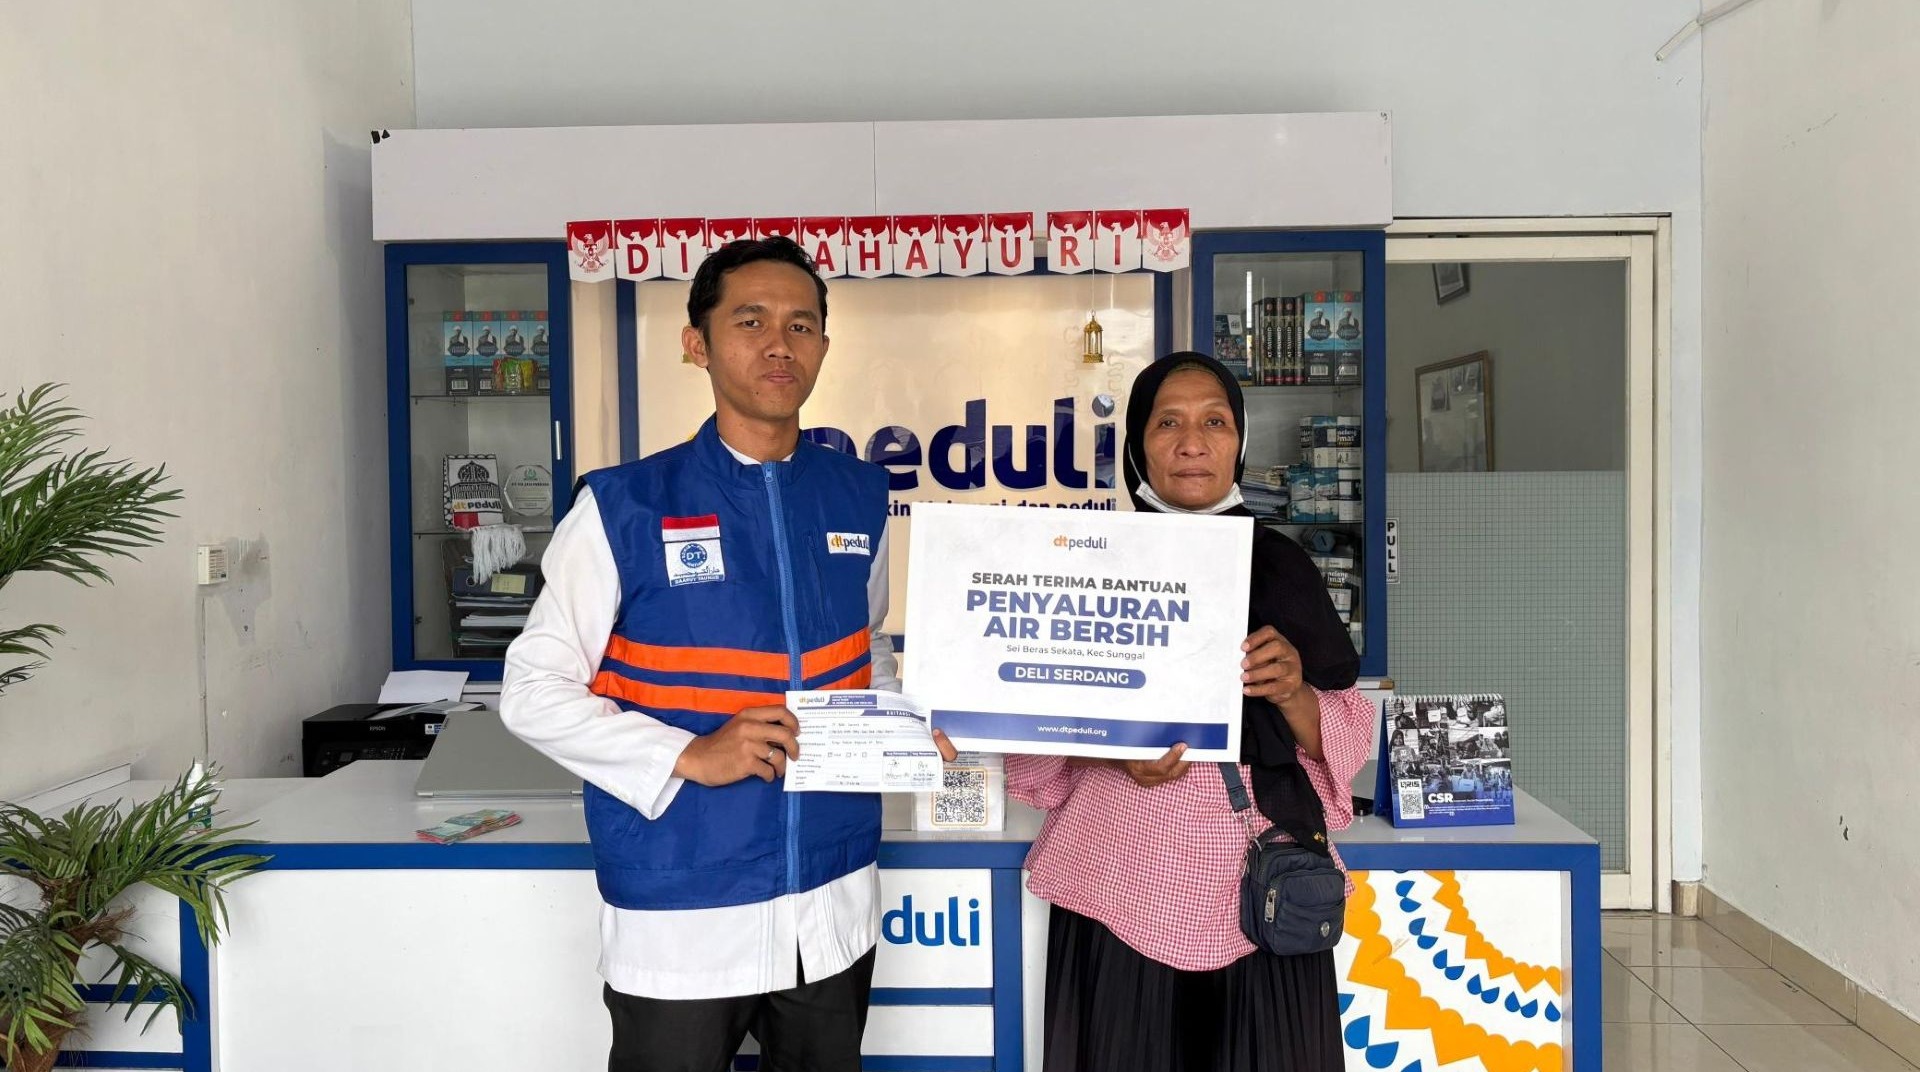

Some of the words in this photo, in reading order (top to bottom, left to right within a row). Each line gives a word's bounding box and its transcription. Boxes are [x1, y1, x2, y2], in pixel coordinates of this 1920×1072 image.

[627, 236, 1022, 275] DIAHAYU
[1060, 235, 1120, 267] RI
[1053, 535, 1107, 551] dtpeduli
[1387, 522, 1396, 573] PULL
[686, 551, 701, 560] DT
[971, 572, 1028, 586] SERAH
[1033, 575, 1096, 589] TERIMA
[1102, 578, 1186, 594] BANTUAN
[966, 590, 1189, 622] PENYALURAN
[983, 616, 1040, 639] AIR
[1050, 619, 1170, 647] BERSIH
[1006, 644, 1020, 653] Sei
[1022, 646, 1049, 654] Beras
[1050, 647, 1085, 657] Sekata,
[1087, 649, 1104, 657] Kec
[1106, 650, 1145, 660] Sunggal
[1015, 666, 1049, 680] DELI
[1053, 669, 1129, 684] SERDANG
[1037, 725, 1107, 736] www.dtpeduli.org
[1428, 793, 1454, 804] CSR
[881, 894, 980, 947] duli
